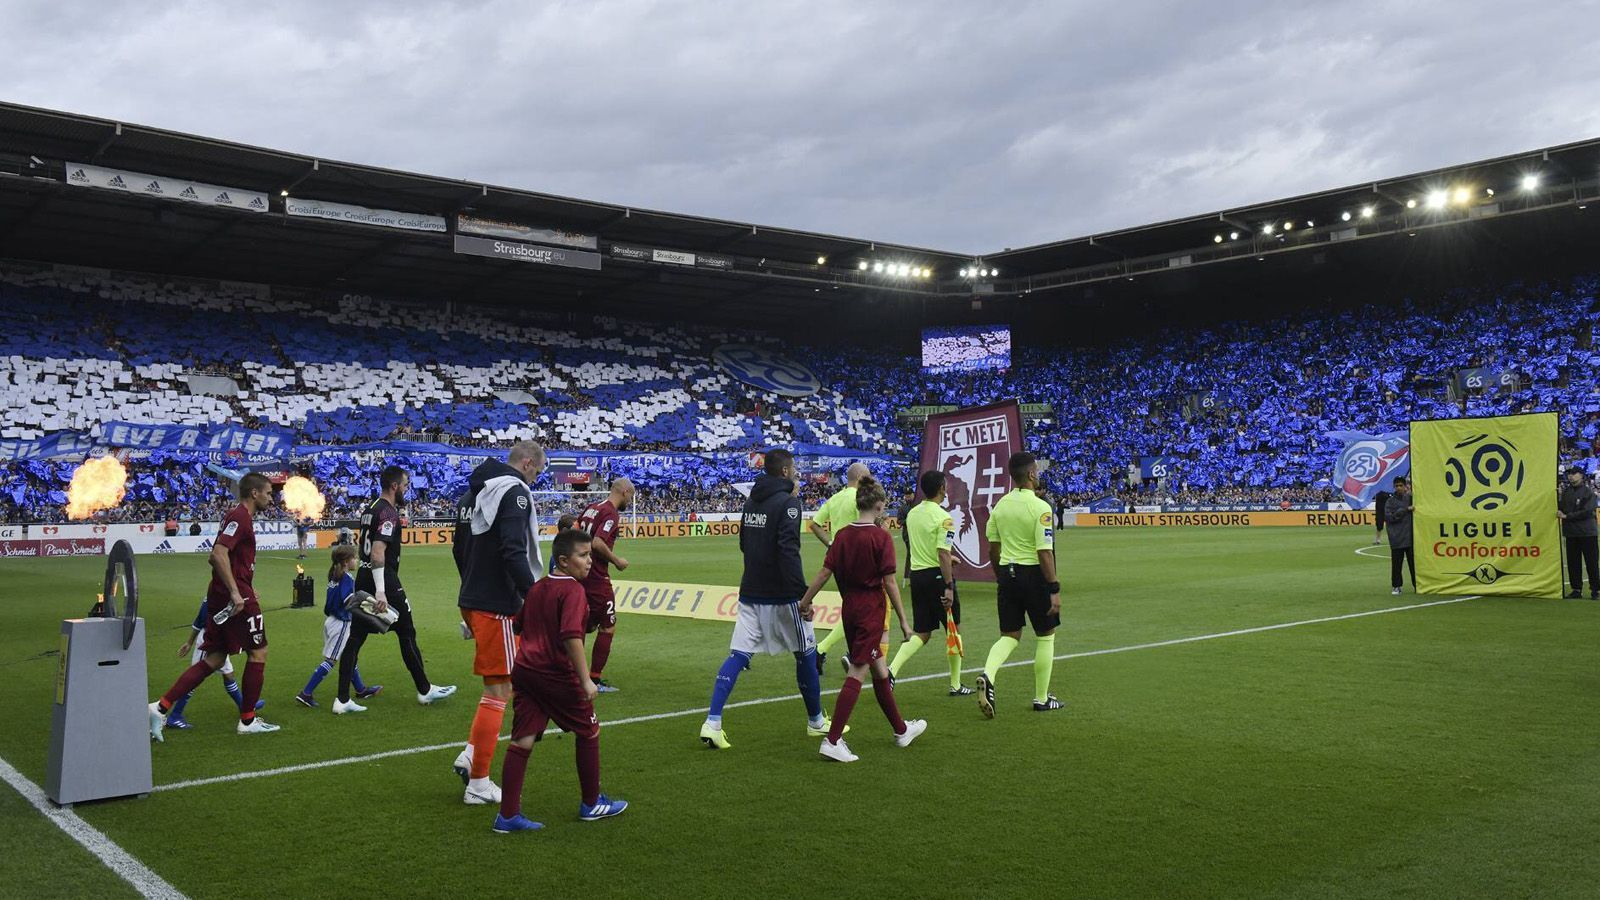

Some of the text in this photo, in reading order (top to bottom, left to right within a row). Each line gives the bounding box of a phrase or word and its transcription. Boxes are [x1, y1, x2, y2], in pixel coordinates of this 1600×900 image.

[344, 211, 395, 225] CroisiEurope
[398, 218, 446, 230] CroisiEurope
[494, 241, 552, 263] Strasbourg
[178, 429, 200, 447] A
[943, 420, 1006, 448] FC METZ
[744, 512, 767, 525] RACING
[1098, 513, 1250, 526] RENAULT STRASBOURG
[618, 523, 741, 538] ENAULT STRASBO
[1440, 521, 1532, 538] LIGUE 1
[1433, 541, 1541, 560] Conforama
[606, 600, 614, 615] 2
[690, 590, 704, 612] 1
[247, 614, 263, 633] 17
